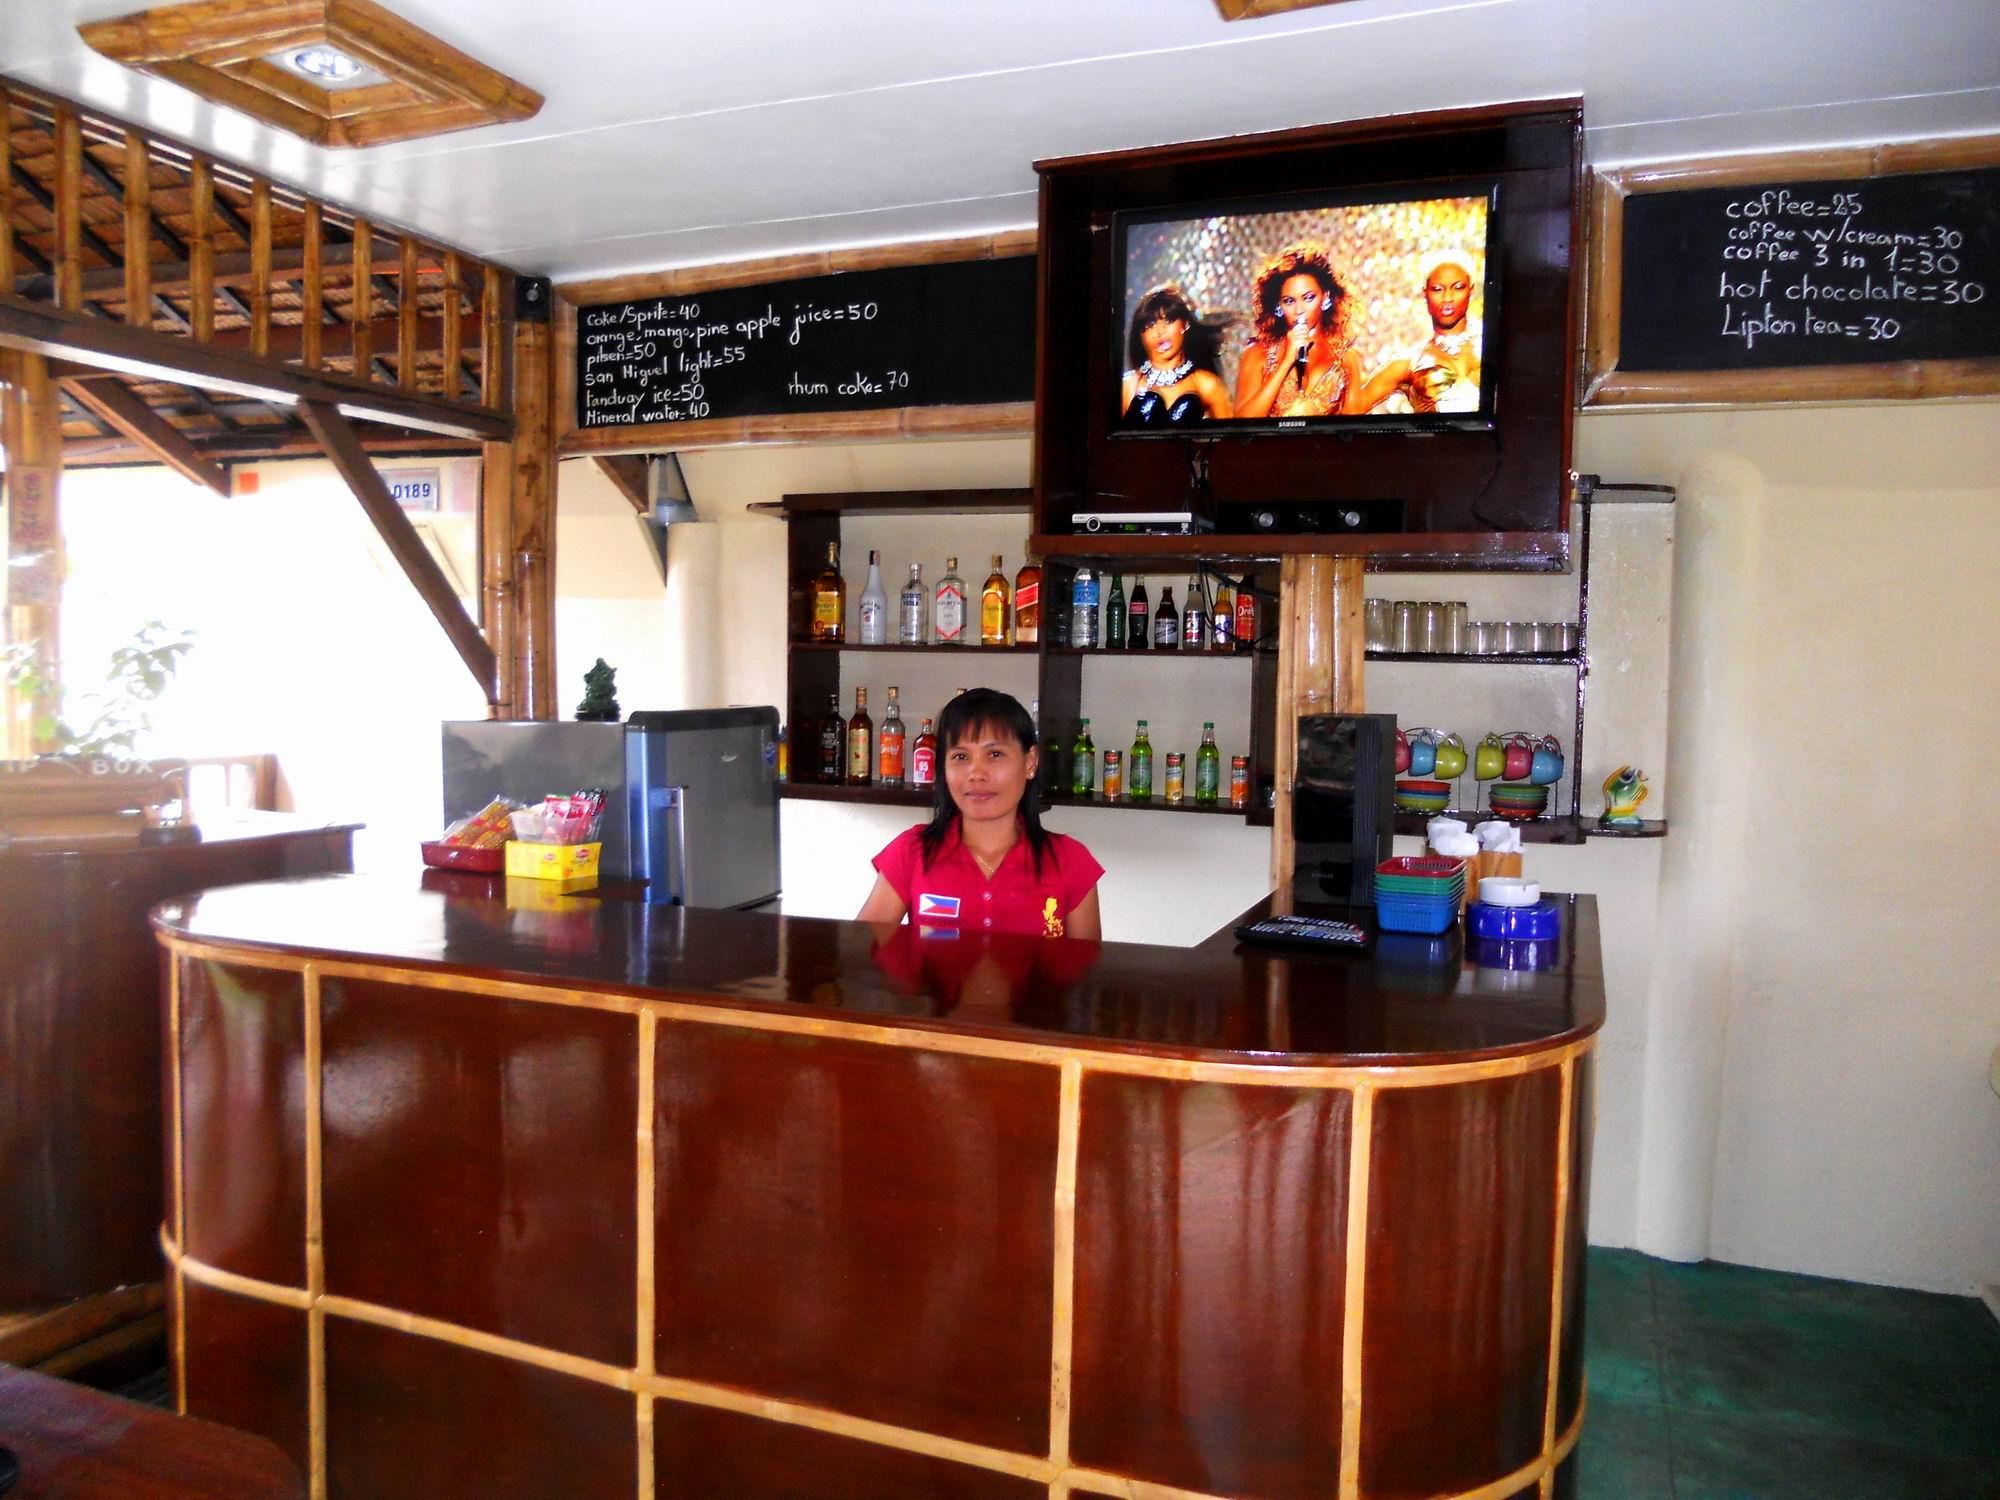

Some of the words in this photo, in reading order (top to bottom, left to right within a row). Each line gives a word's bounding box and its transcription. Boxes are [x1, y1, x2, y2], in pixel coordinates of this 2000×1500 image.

[1728, 221, 1795, 240] coffee
[1723, 244, 1799, 261] coffee
[1815, 244, 1829, 266] 3
[1842, 252, 1865, 269] in
[1719, 269, 1771, 298] hot
[736, 304, 780, 340] apple
[1722, 302, 1795, 349] Lipton
[585, 373, 614, 386] san
[788, 372, 828, 395] rhum
[586, 406, 636, 426] Mineral
[92, 759, 153, 775] BOX
